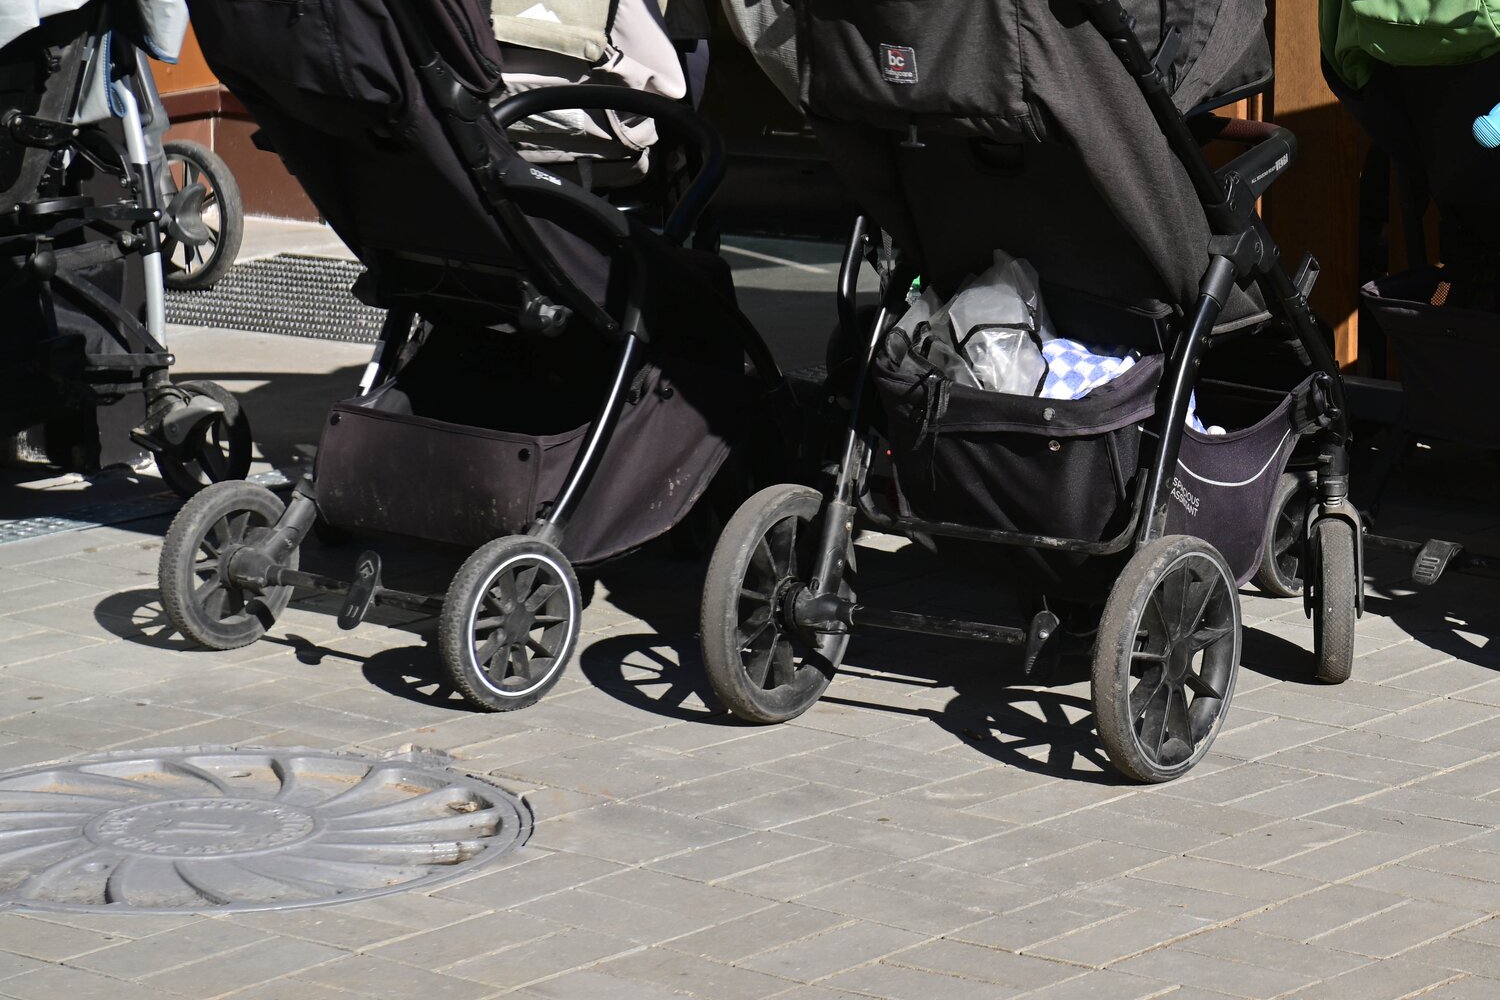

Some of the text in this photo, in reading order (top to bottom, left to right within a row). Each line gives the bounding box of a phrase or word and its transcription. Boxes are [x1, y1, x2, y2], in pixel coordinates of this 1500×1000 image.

[888, 49, 905, 67] bc
[1170, 487, 1199, 518] ASSISTANT
[1172, 476, 1200, 508] SPACIOUS
